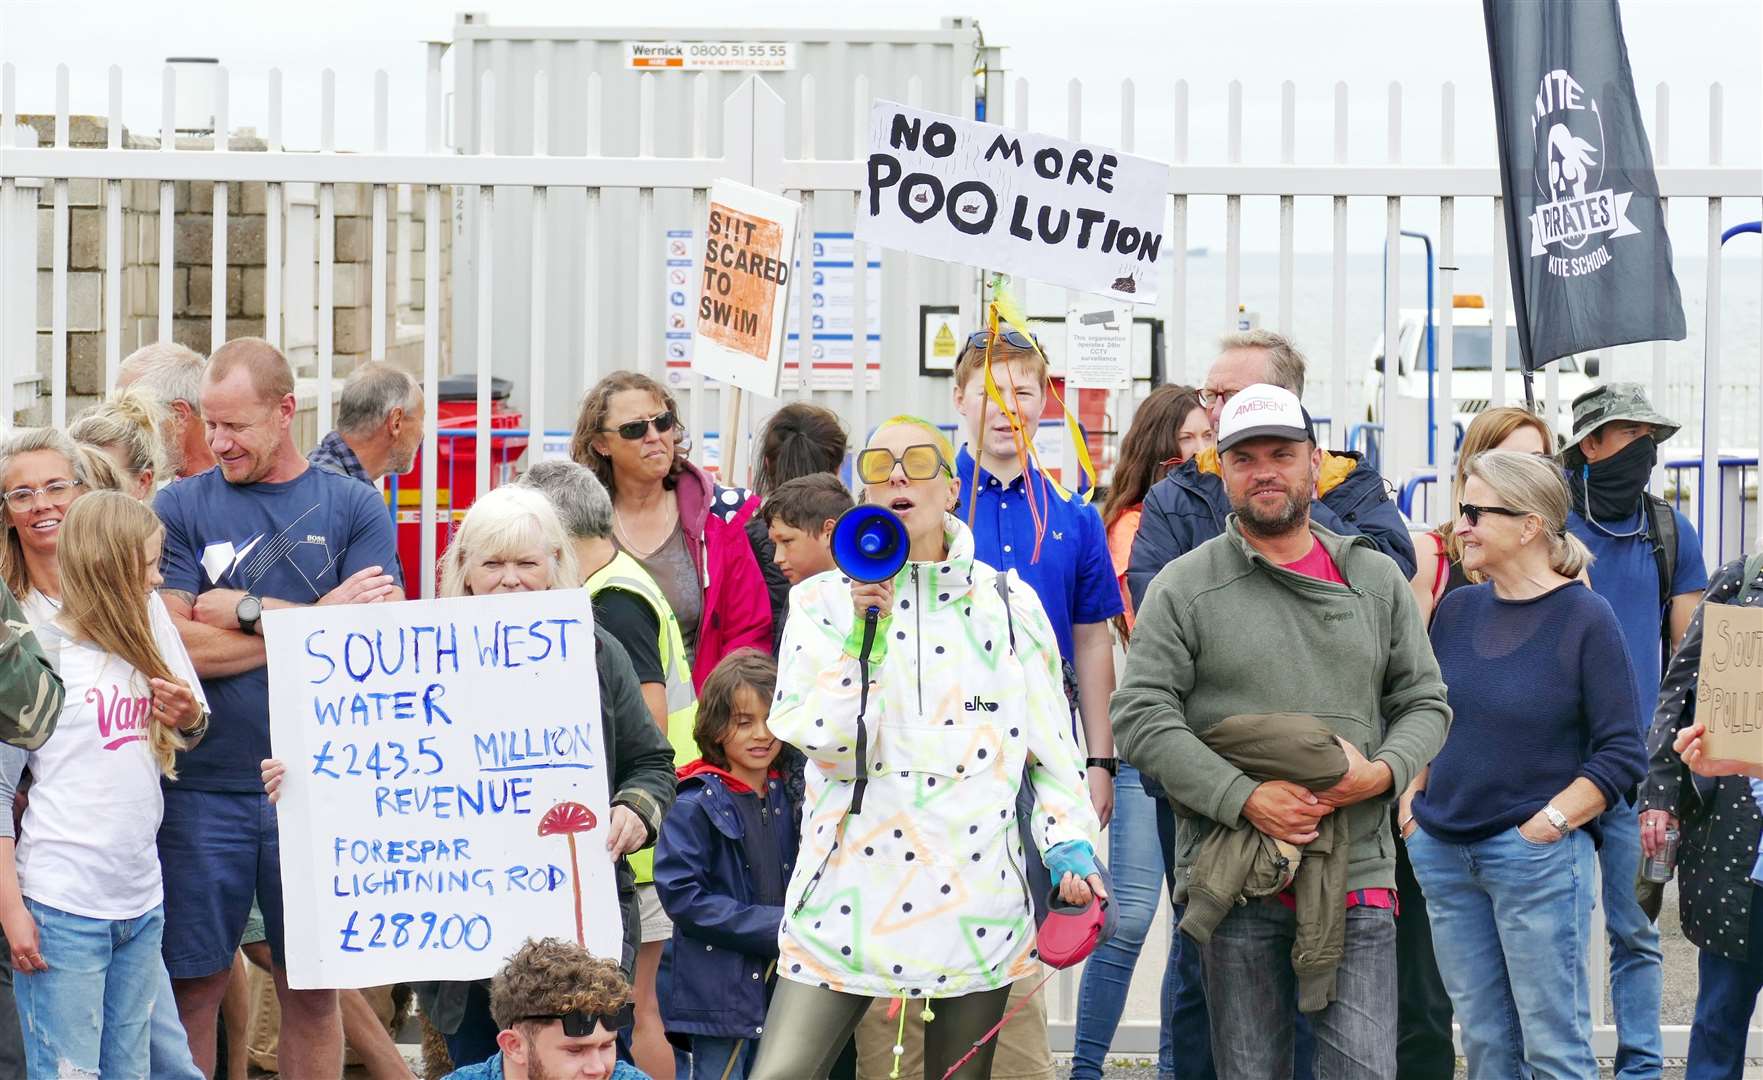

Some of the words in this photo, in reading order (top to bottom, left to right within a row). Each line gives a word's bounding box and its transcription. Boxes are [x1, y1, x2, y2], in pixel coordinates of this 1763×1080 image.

[632, 45, 683, 56] Wernick
[690, 45, 727, 56] 0800
[731, 45, 744, 56] 51
[749, 45, 765, 56] 55
[769, 45, 787, 56] 55
[691, 58, 785, 66] www.wernick.co.uk
[1536, 69, 1585, 120] KITE
[890, 113, 957, 158] NO
[984, 133, 1118, 194] MORE
[709, 210, 757, 246] S!!T
[867, 153, 1163, 263] POOLUTION
[1543, 195, 1611, 240] PIRATES
[704, 266, 732, 296] TO
[705, 238, 788, 286] SCARED
[1548, 254, 1570, 278] KITE
[1571, 245, 1613, 277] SCHOOL
[307, 534, 325, 542] BOSS
[304, 622, 459, 684] SOUTH
[473, 619, 582, 668] WEST
[84, 685, 149, 738] Van
[314, 683, 452, 726] WATER
[312, 736, 444, 779] £243.5
[473, 723, 593, 766] MILLION
[375, 777, 533, 818] REVENUE
[333, 837, 472, 866] FORESPAR
[333, 868, 495, 897] LIGHTNING
[504, 864, 568, 892] ROD
[340, 911, 493, 952] £289.00
